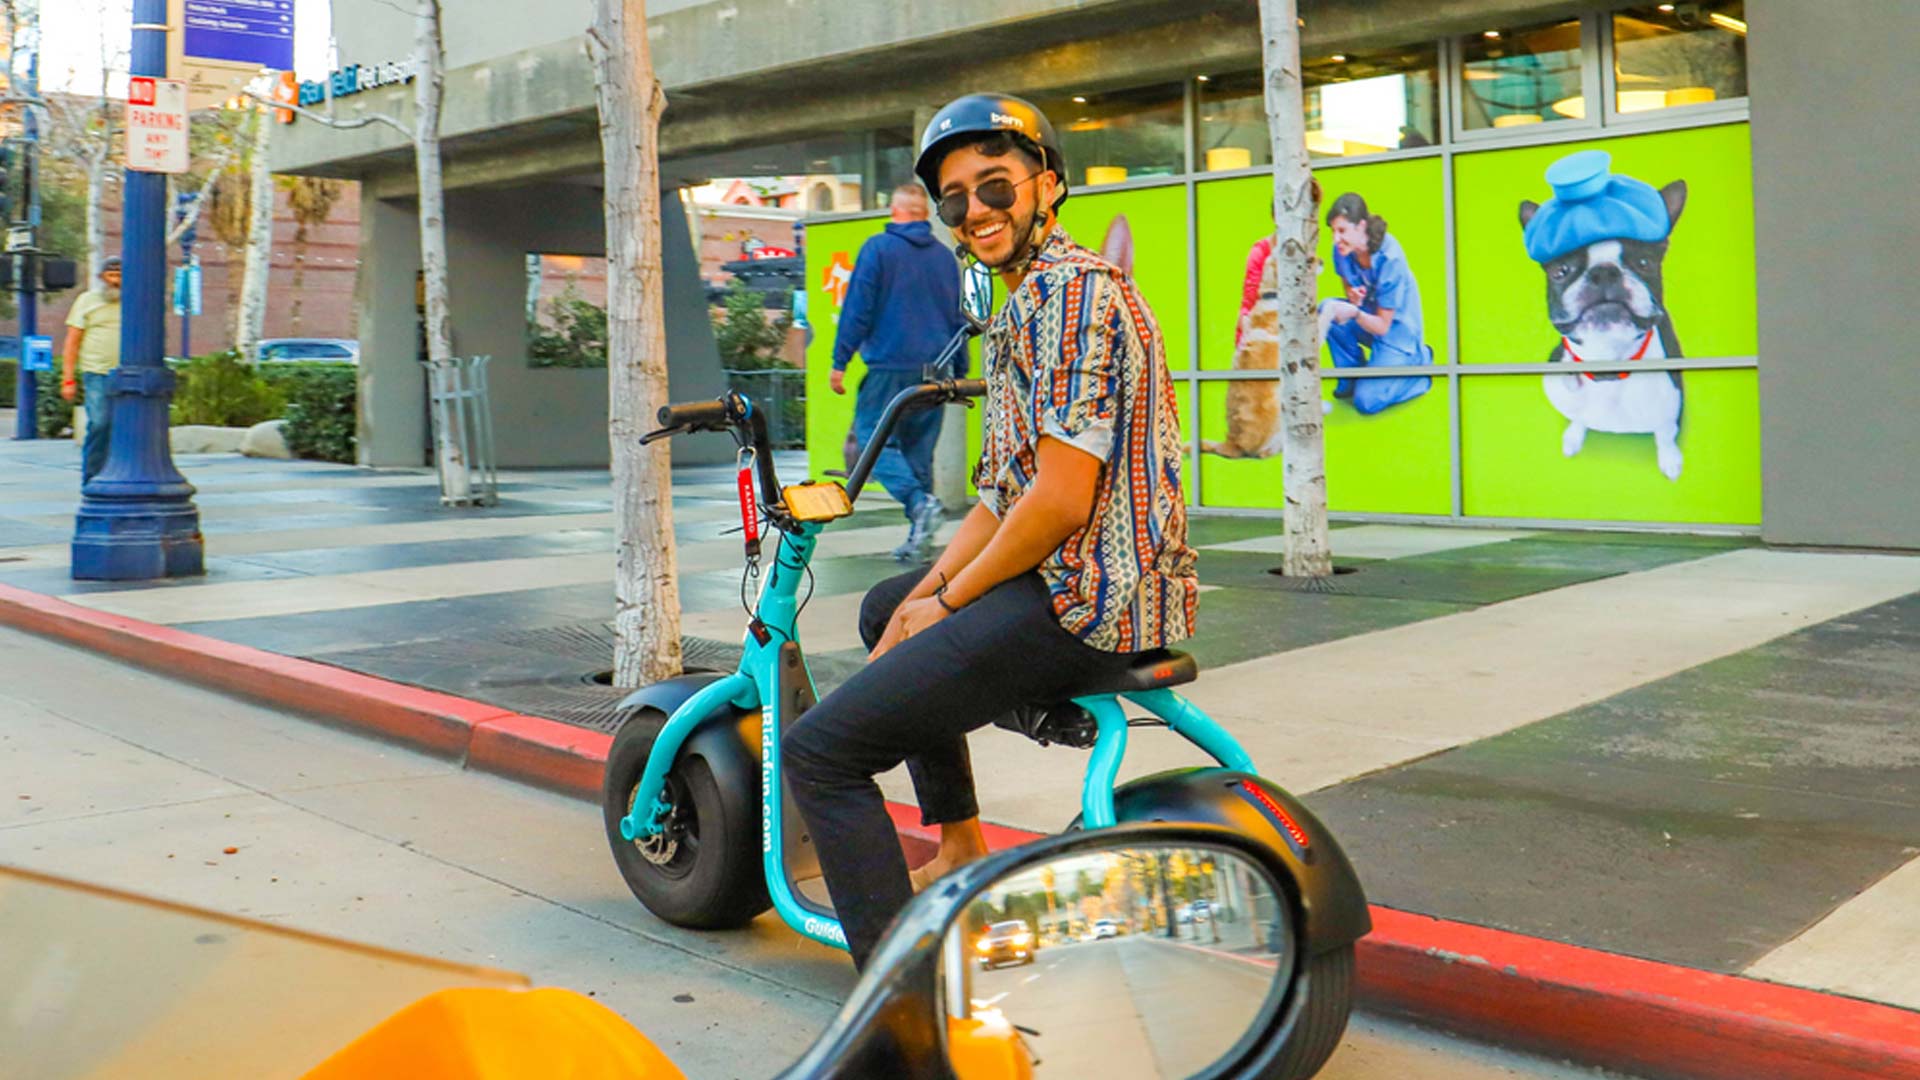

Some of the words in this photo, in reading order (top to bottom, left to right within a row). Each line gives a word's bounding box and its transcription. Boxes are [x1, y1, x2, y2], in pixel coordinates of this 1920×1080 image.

[131, 81, 154, 103] NO
[132, 109, 184, 131] PARKING
[991, 112, 1024, 128] bern
[146, 132, 168, 145] ANY
